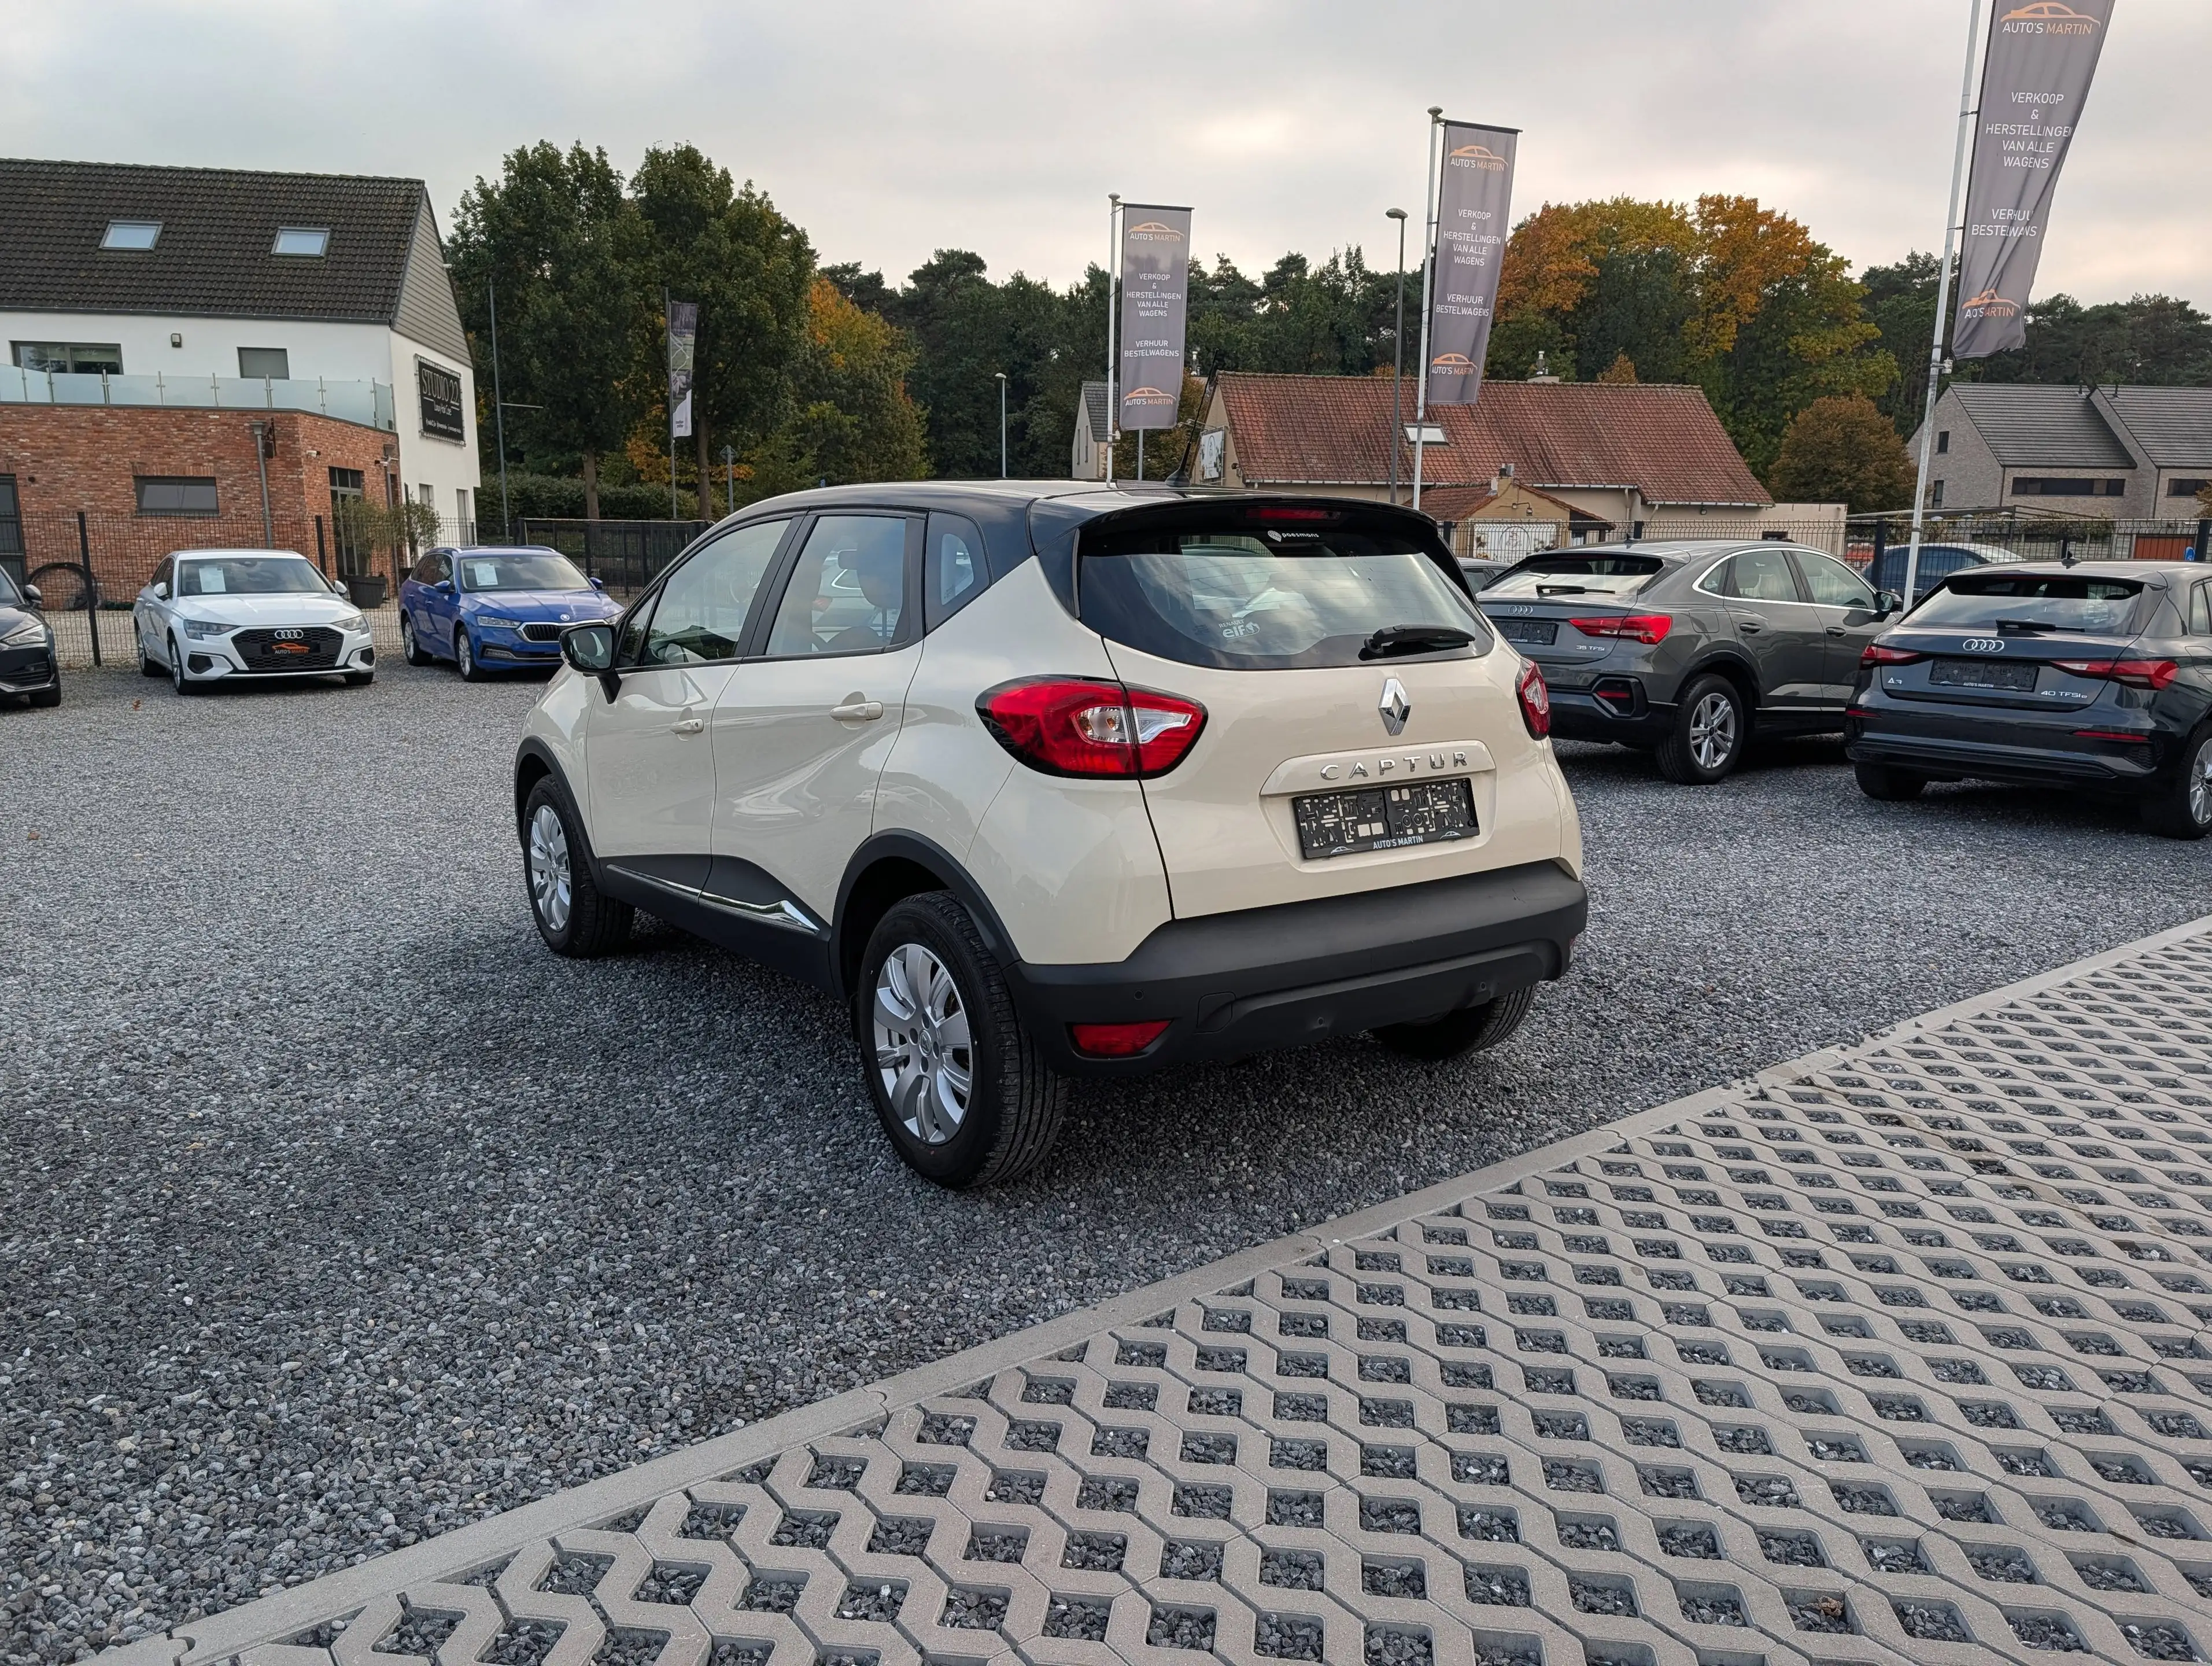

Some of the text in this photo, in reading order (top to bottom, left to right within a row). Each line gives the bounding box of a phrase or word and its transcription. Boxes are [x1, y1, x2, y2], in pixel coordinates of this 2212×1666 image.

[2002, 22, 2092, 35] AUTO'S MARTIN
[2011, 91, 2064, 105] VERKOOP
[2030, 109, 2039, 120] &
[2002, 140, 2055, 153] VAN ALLE
[1450, 158, 1505, 172] AUTO'S MARTIN
[2003, 156, 2049, 168] WAGENS
[1458, 209, 1491, 220] VERKOOP
[1471, 222, 1476, 230] &
[1129, 233, 1153, 241] AUTO'S
[1443, 231, 1501, 245] HERSTELLINGEN
[1453, 244, 1487, 255] VAN ALLE
[1454, 256, 1485, 266] WAGENS
[1127, 291, 1181, 300] HERSTELLINGEN
[1447, 293, 1483, 304] VERHUUR
[1436, 304, 1490, 316] BESTELWAGENS
[1135, 340, 1169, 348] VERHUUR
[1124, 349, 1180, 357] BESTELWAGENS
[1431, 366, 1452, 375] AUTO'S
[422, 368, 460, 406] STUDIO 22
[1125, 397, 1173, 406] AUTO'S MARTIN
[1218, 619, 1245, 628] RENAULT
[1223, 625, 1245, 638] elf
[1320, 751, 1468, 781] CAPTUR
[1373, 835, 1423, 850] AUTO'S MARTIN
